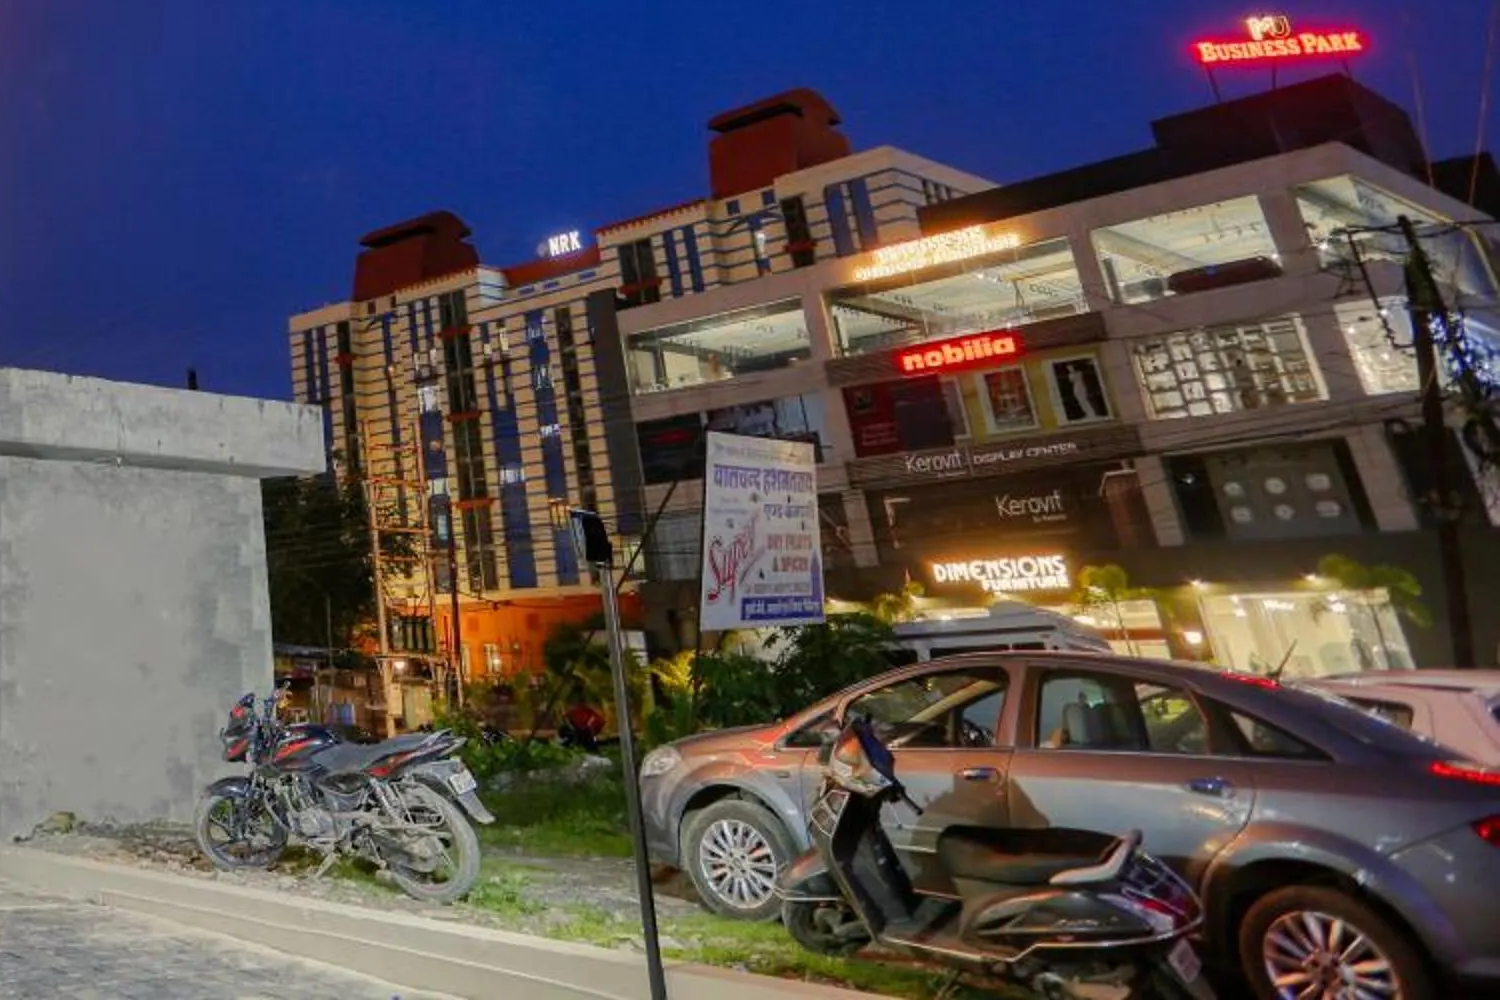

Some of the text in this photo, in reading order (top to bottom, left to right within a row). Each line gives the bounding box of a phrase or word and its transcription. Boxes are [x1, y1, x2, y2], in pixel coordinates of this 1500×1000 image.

[1198, 31, 1363, 63] BUSINESS PARK
[548, 230, 581, 257] NRK
[902, 336, 1016, 371] nobilia
[904, 449, 963, 474] Kerovit
[995, 489, 1063, 518] Kerovit
[931, 554, 1067, 584] DIMENSIONS
